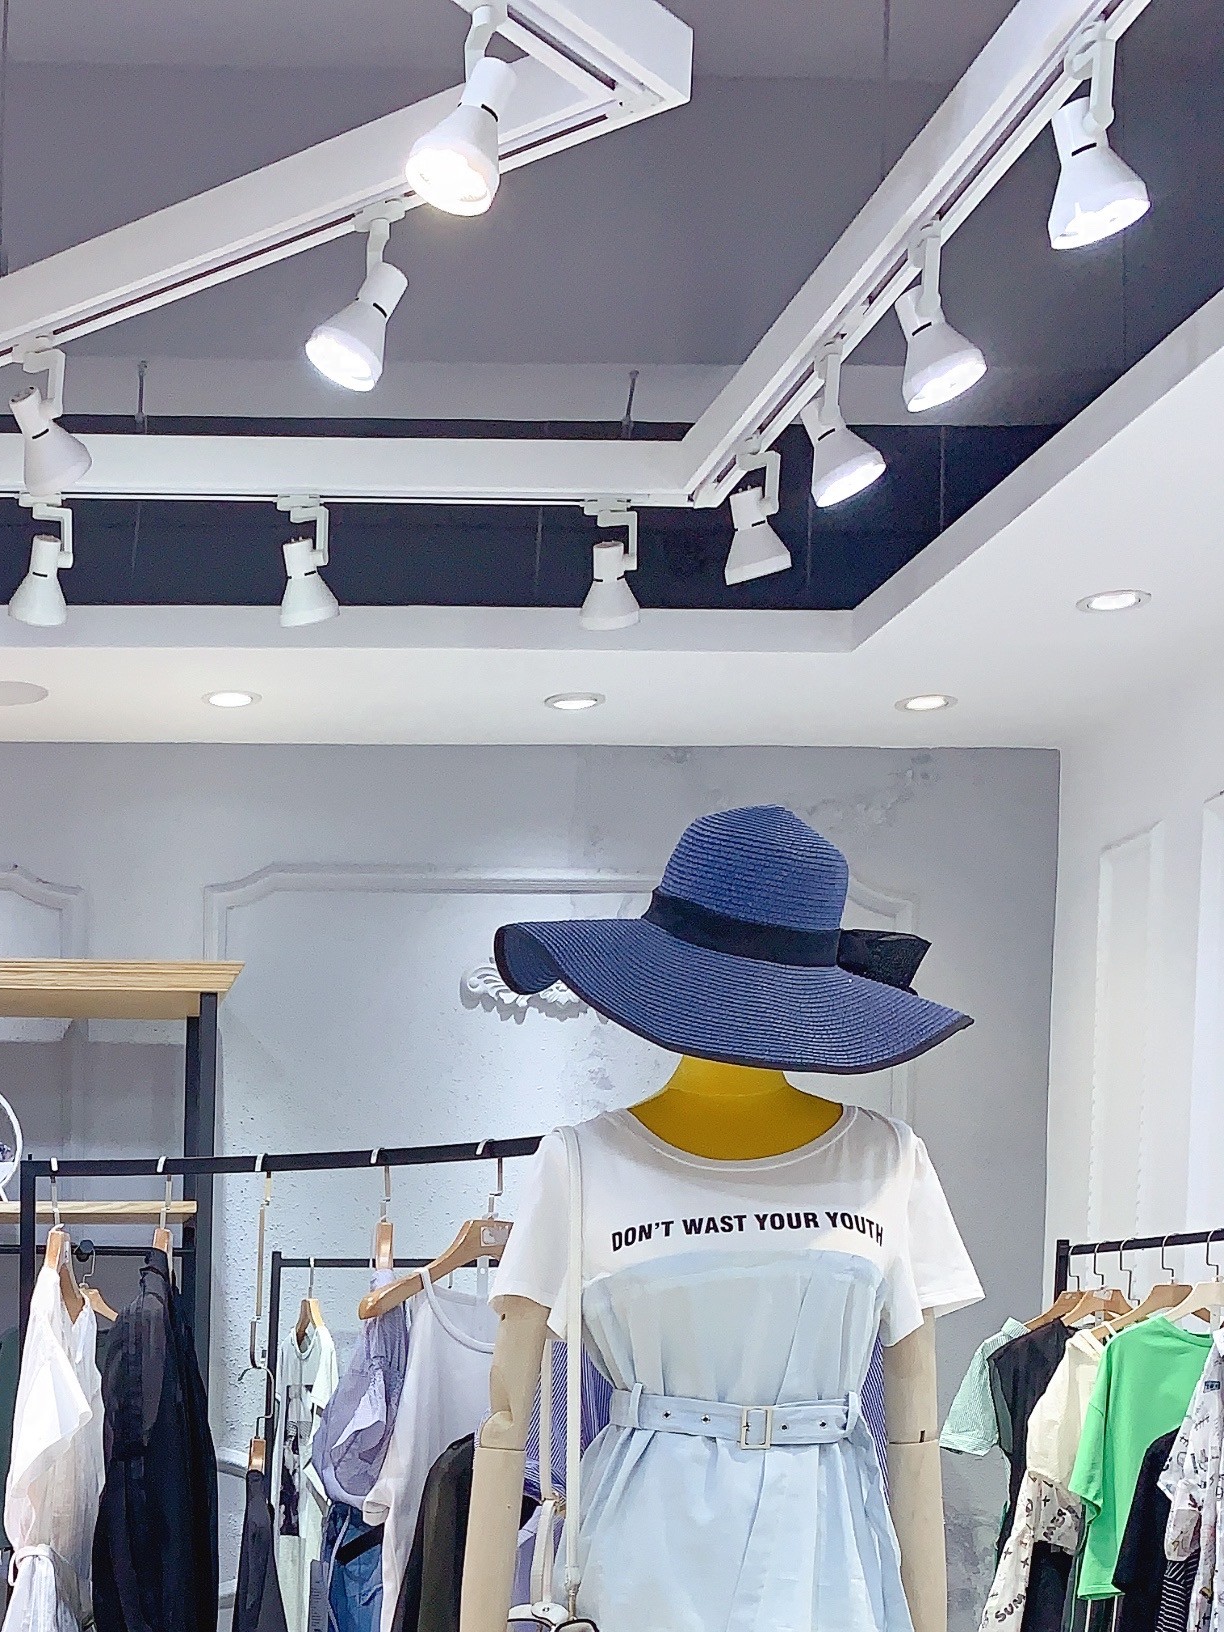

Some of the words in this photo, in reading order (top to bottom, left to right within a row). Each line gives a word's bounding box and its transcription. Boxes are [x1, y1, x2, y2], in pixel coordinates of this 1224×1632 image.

[611, 1220, 675, 1252] DON'T
[682, 1214, 747, 1236] WAST
[753, 1211, 820, 1232] YOUR
[825, 1210, 884, 1247] YOUTH
